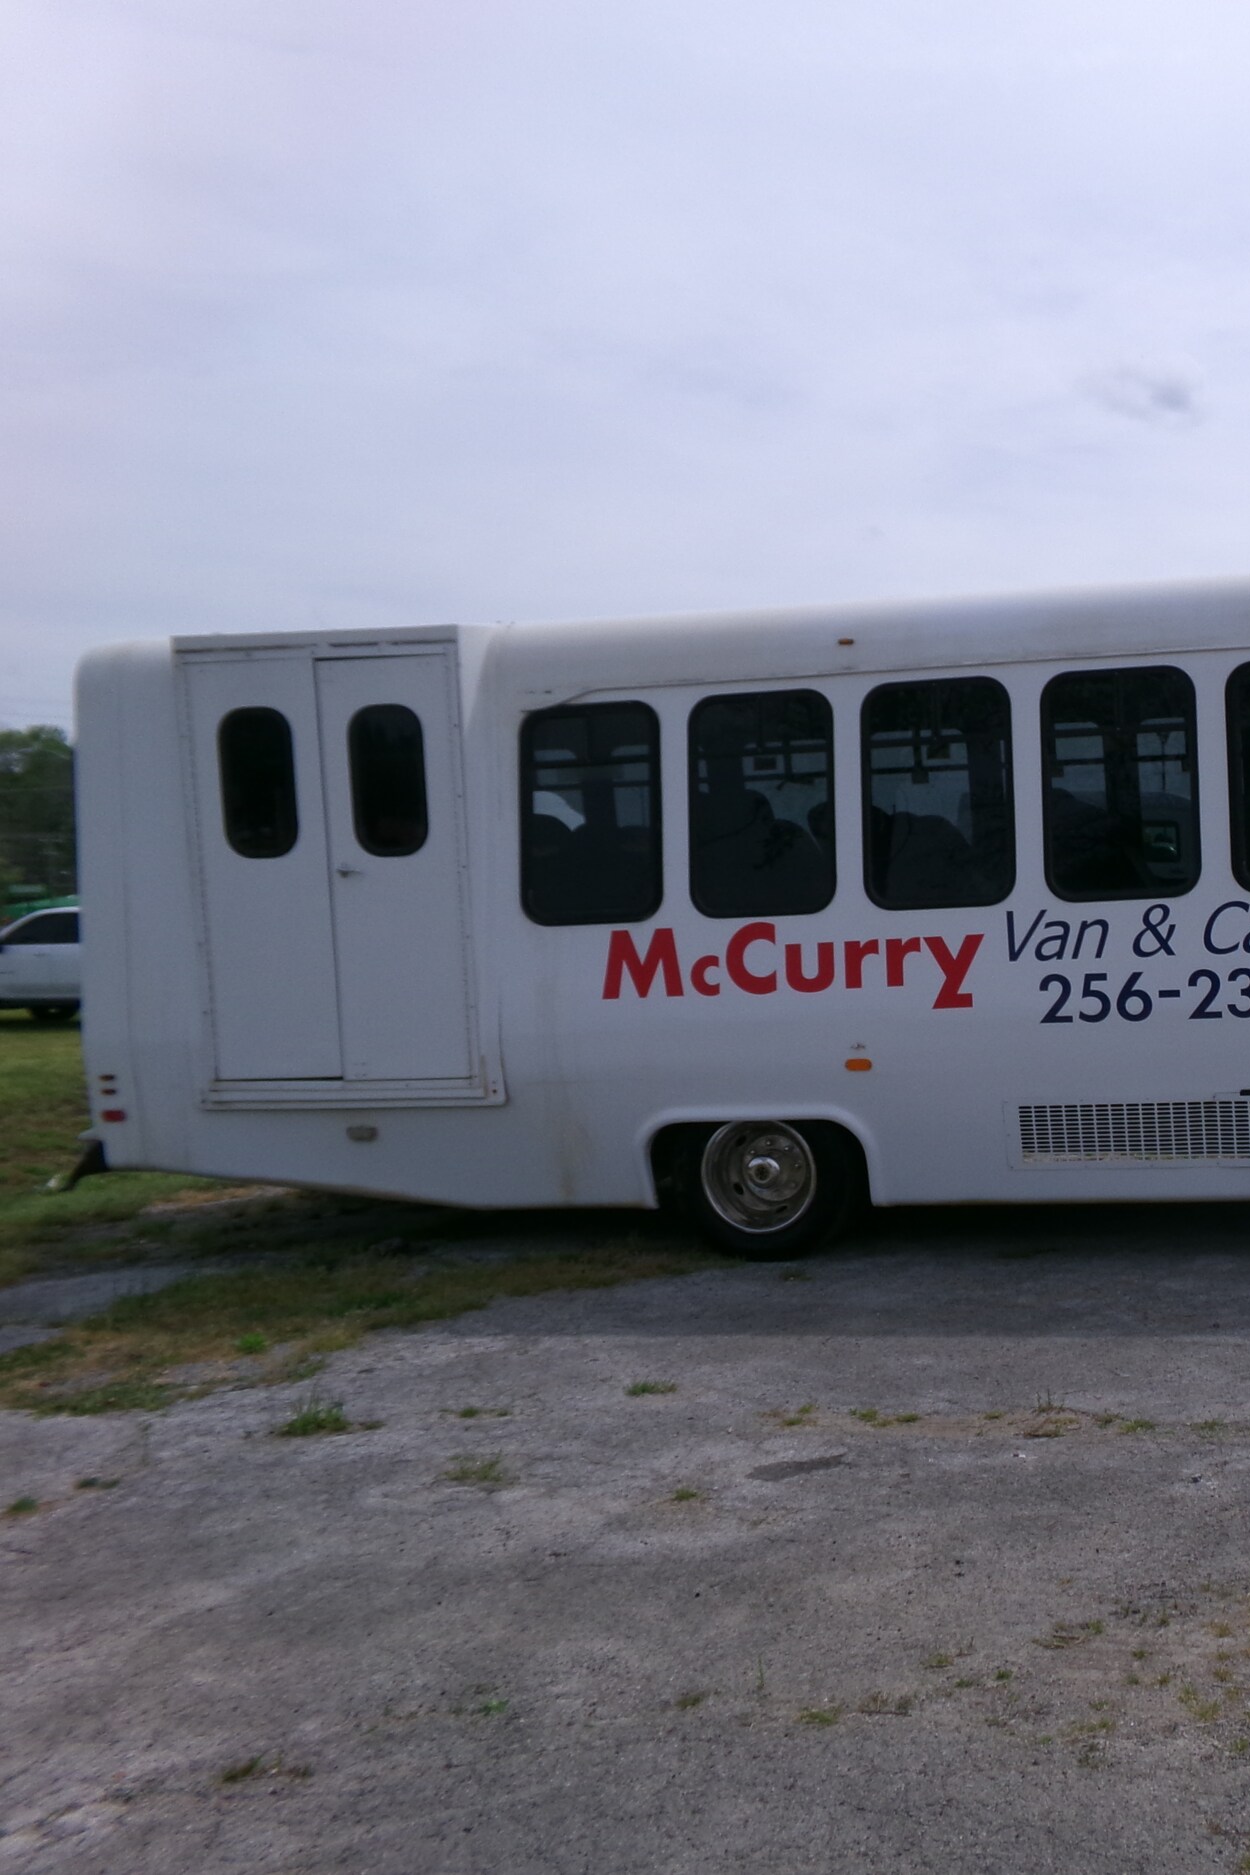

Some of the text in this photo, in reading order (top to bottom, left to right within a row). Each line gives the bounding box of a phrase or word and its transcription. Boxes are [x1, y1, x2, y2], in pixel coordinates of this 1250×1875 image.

[602, 921, 985, 1009] McCurry
[1004, 908, 1110, 962] Van
[1131, 902, 1177, 958] &
